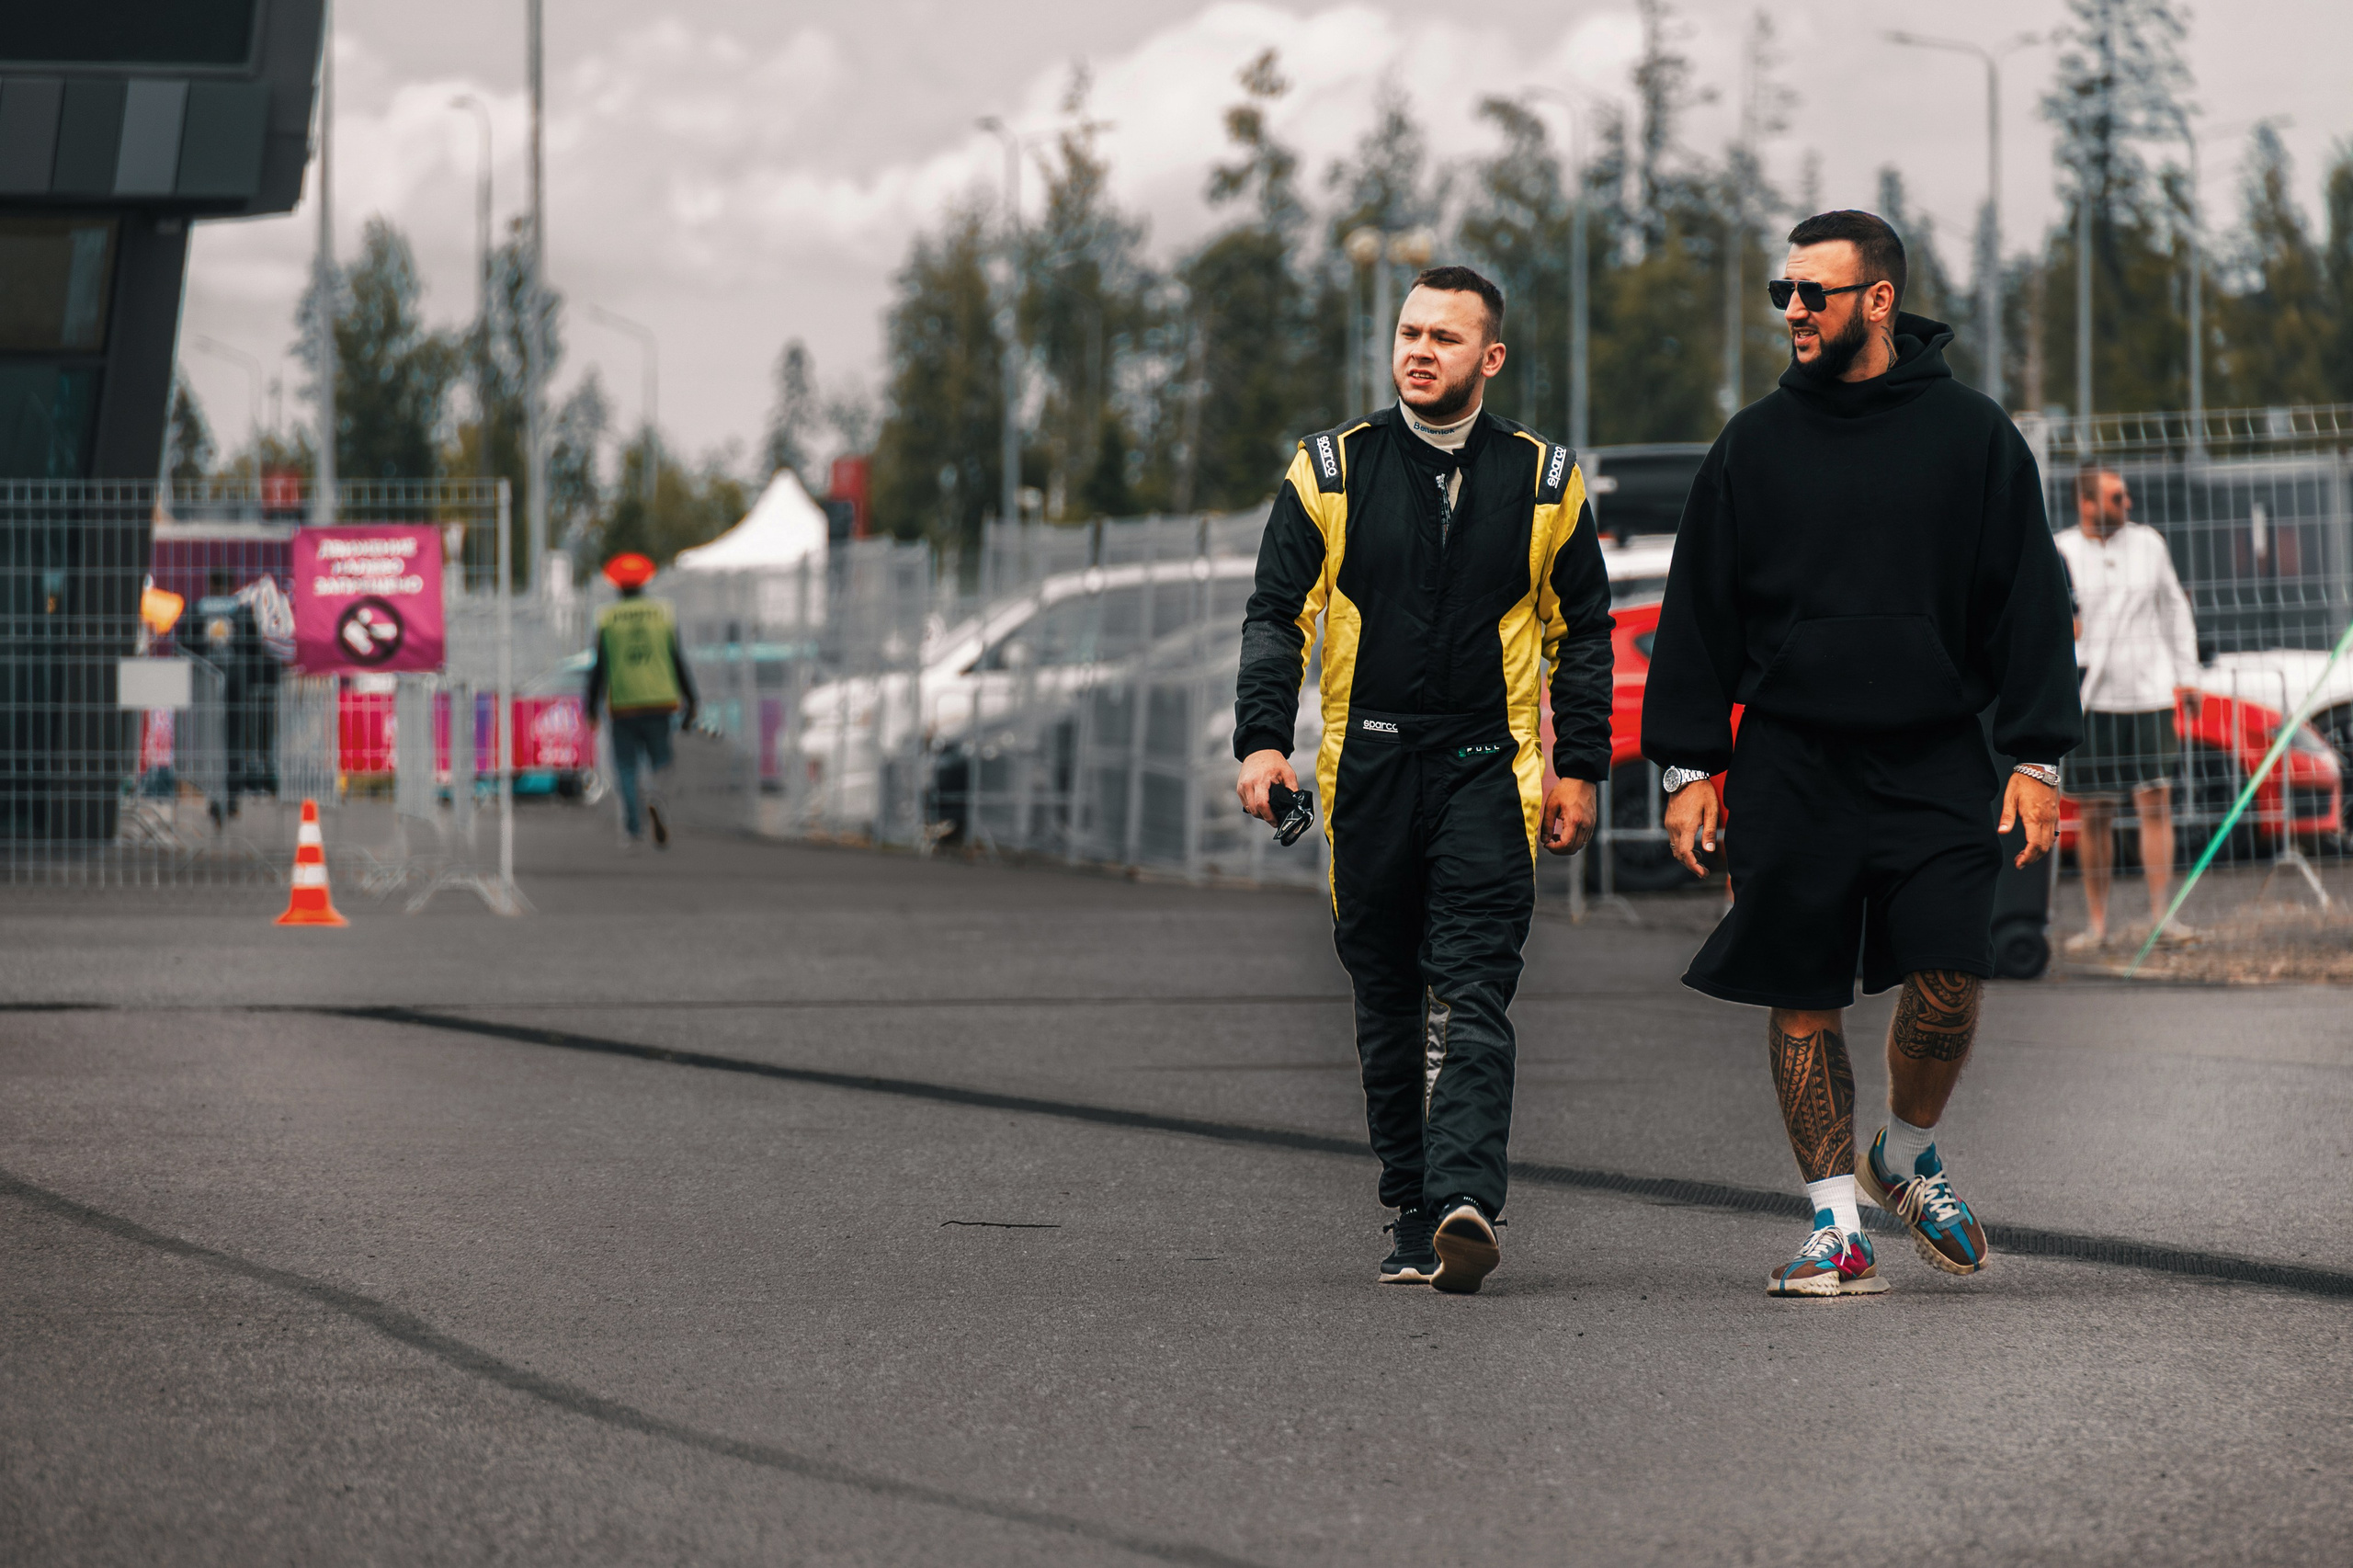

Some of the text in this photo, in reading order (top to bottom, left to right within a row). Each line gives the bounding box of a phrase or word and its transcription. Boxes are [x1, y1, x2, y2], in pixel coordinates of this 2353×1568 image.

[1317, 436, 1336, 477] sparco
[1547, 446, 1566, 488] sparco
[1466, 744, 1500, 753] FULL
